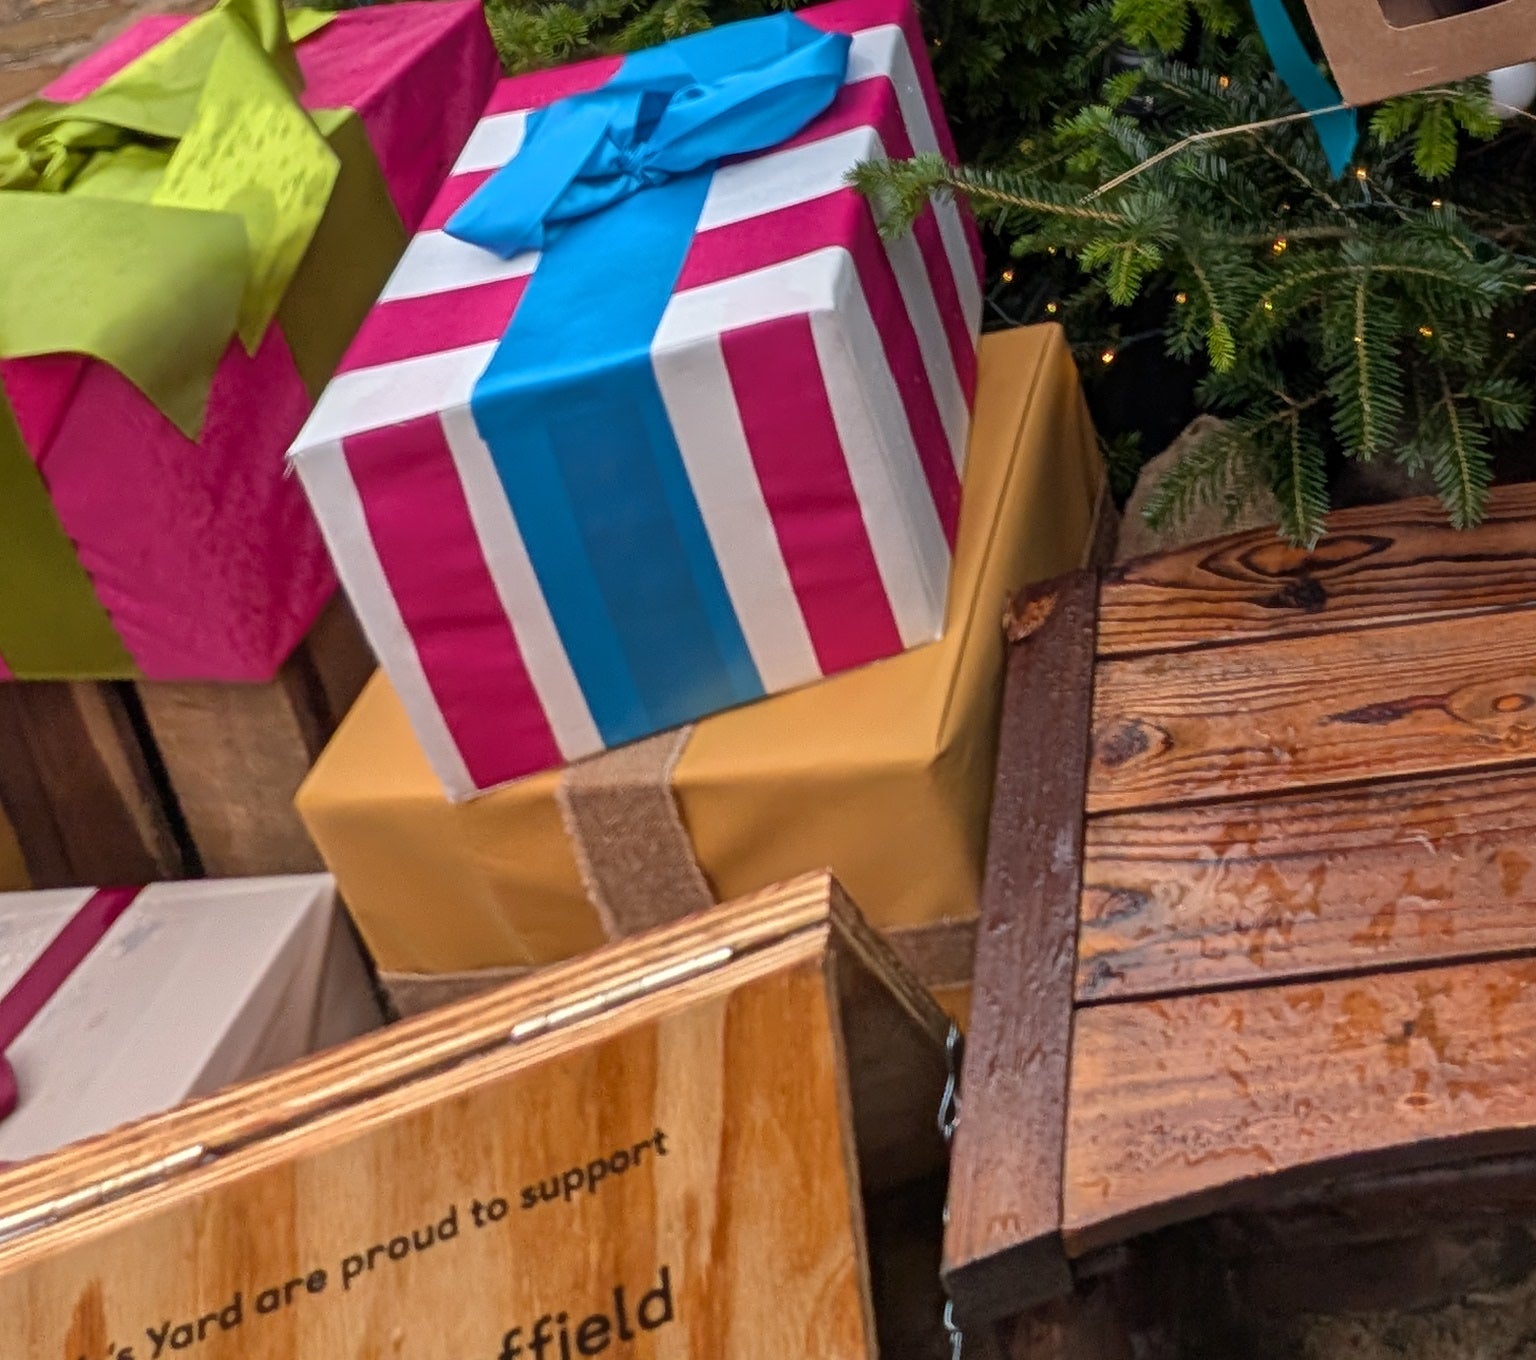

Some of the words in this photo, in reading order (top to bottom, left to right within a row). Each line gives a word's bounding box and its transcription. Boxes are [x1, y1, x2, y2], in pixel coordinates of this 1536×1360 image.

[146, 1291, 243, 1360] Yard
[255, 1268, 328, 1317] are
[340, 1203, 460, 1290] proud
[469, 1196, 510, 1229] to
[519, 1127, 670, 1211] support
